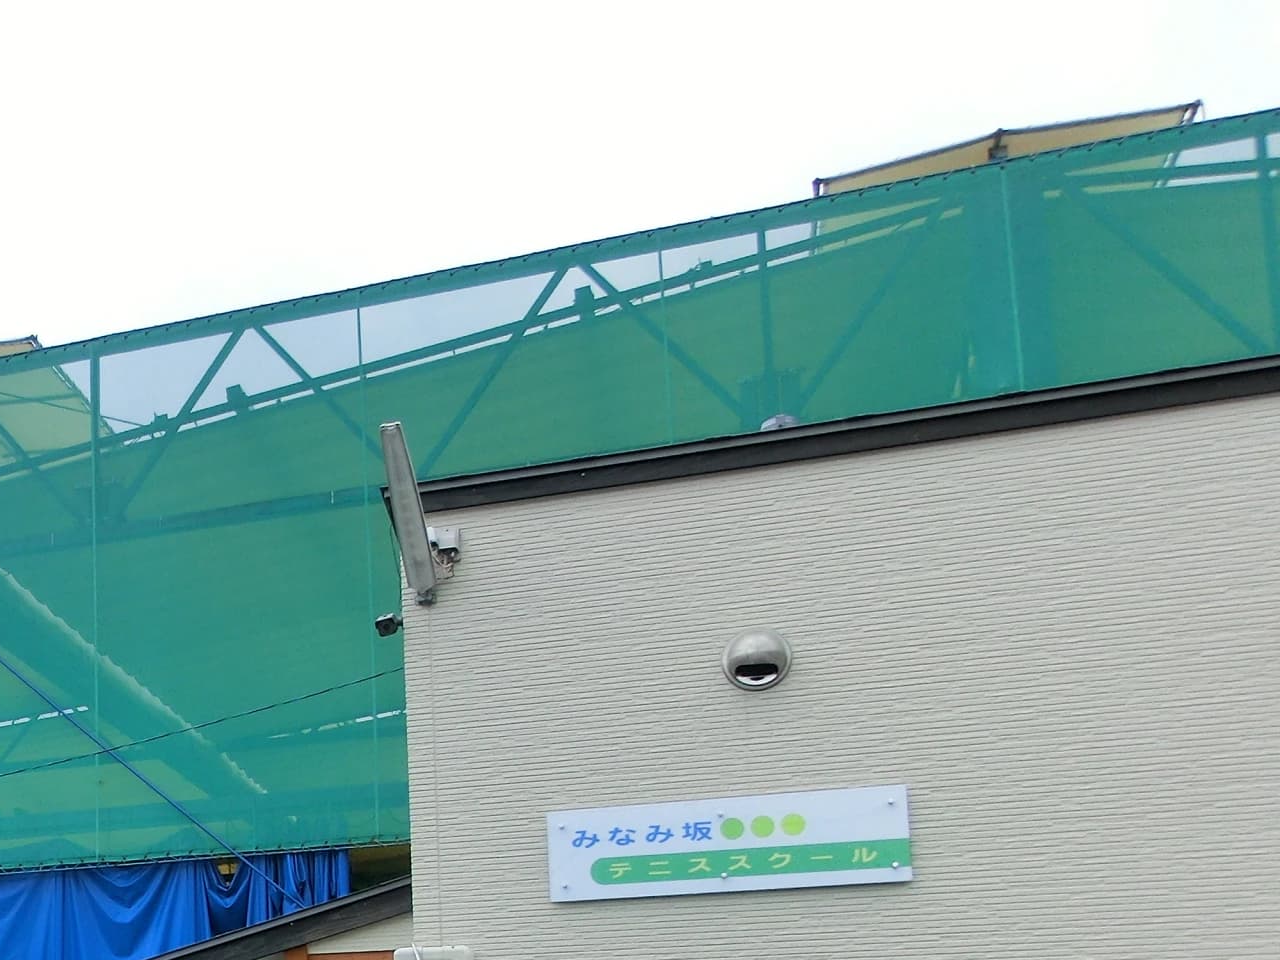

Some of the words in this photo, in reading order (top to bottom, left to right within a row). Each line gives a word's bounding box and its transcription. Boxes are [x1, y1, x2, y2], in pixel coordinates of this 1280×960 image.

[572, 820, 713, 849] みなみ坂
[609, 847, 877, 878] テニススクール
